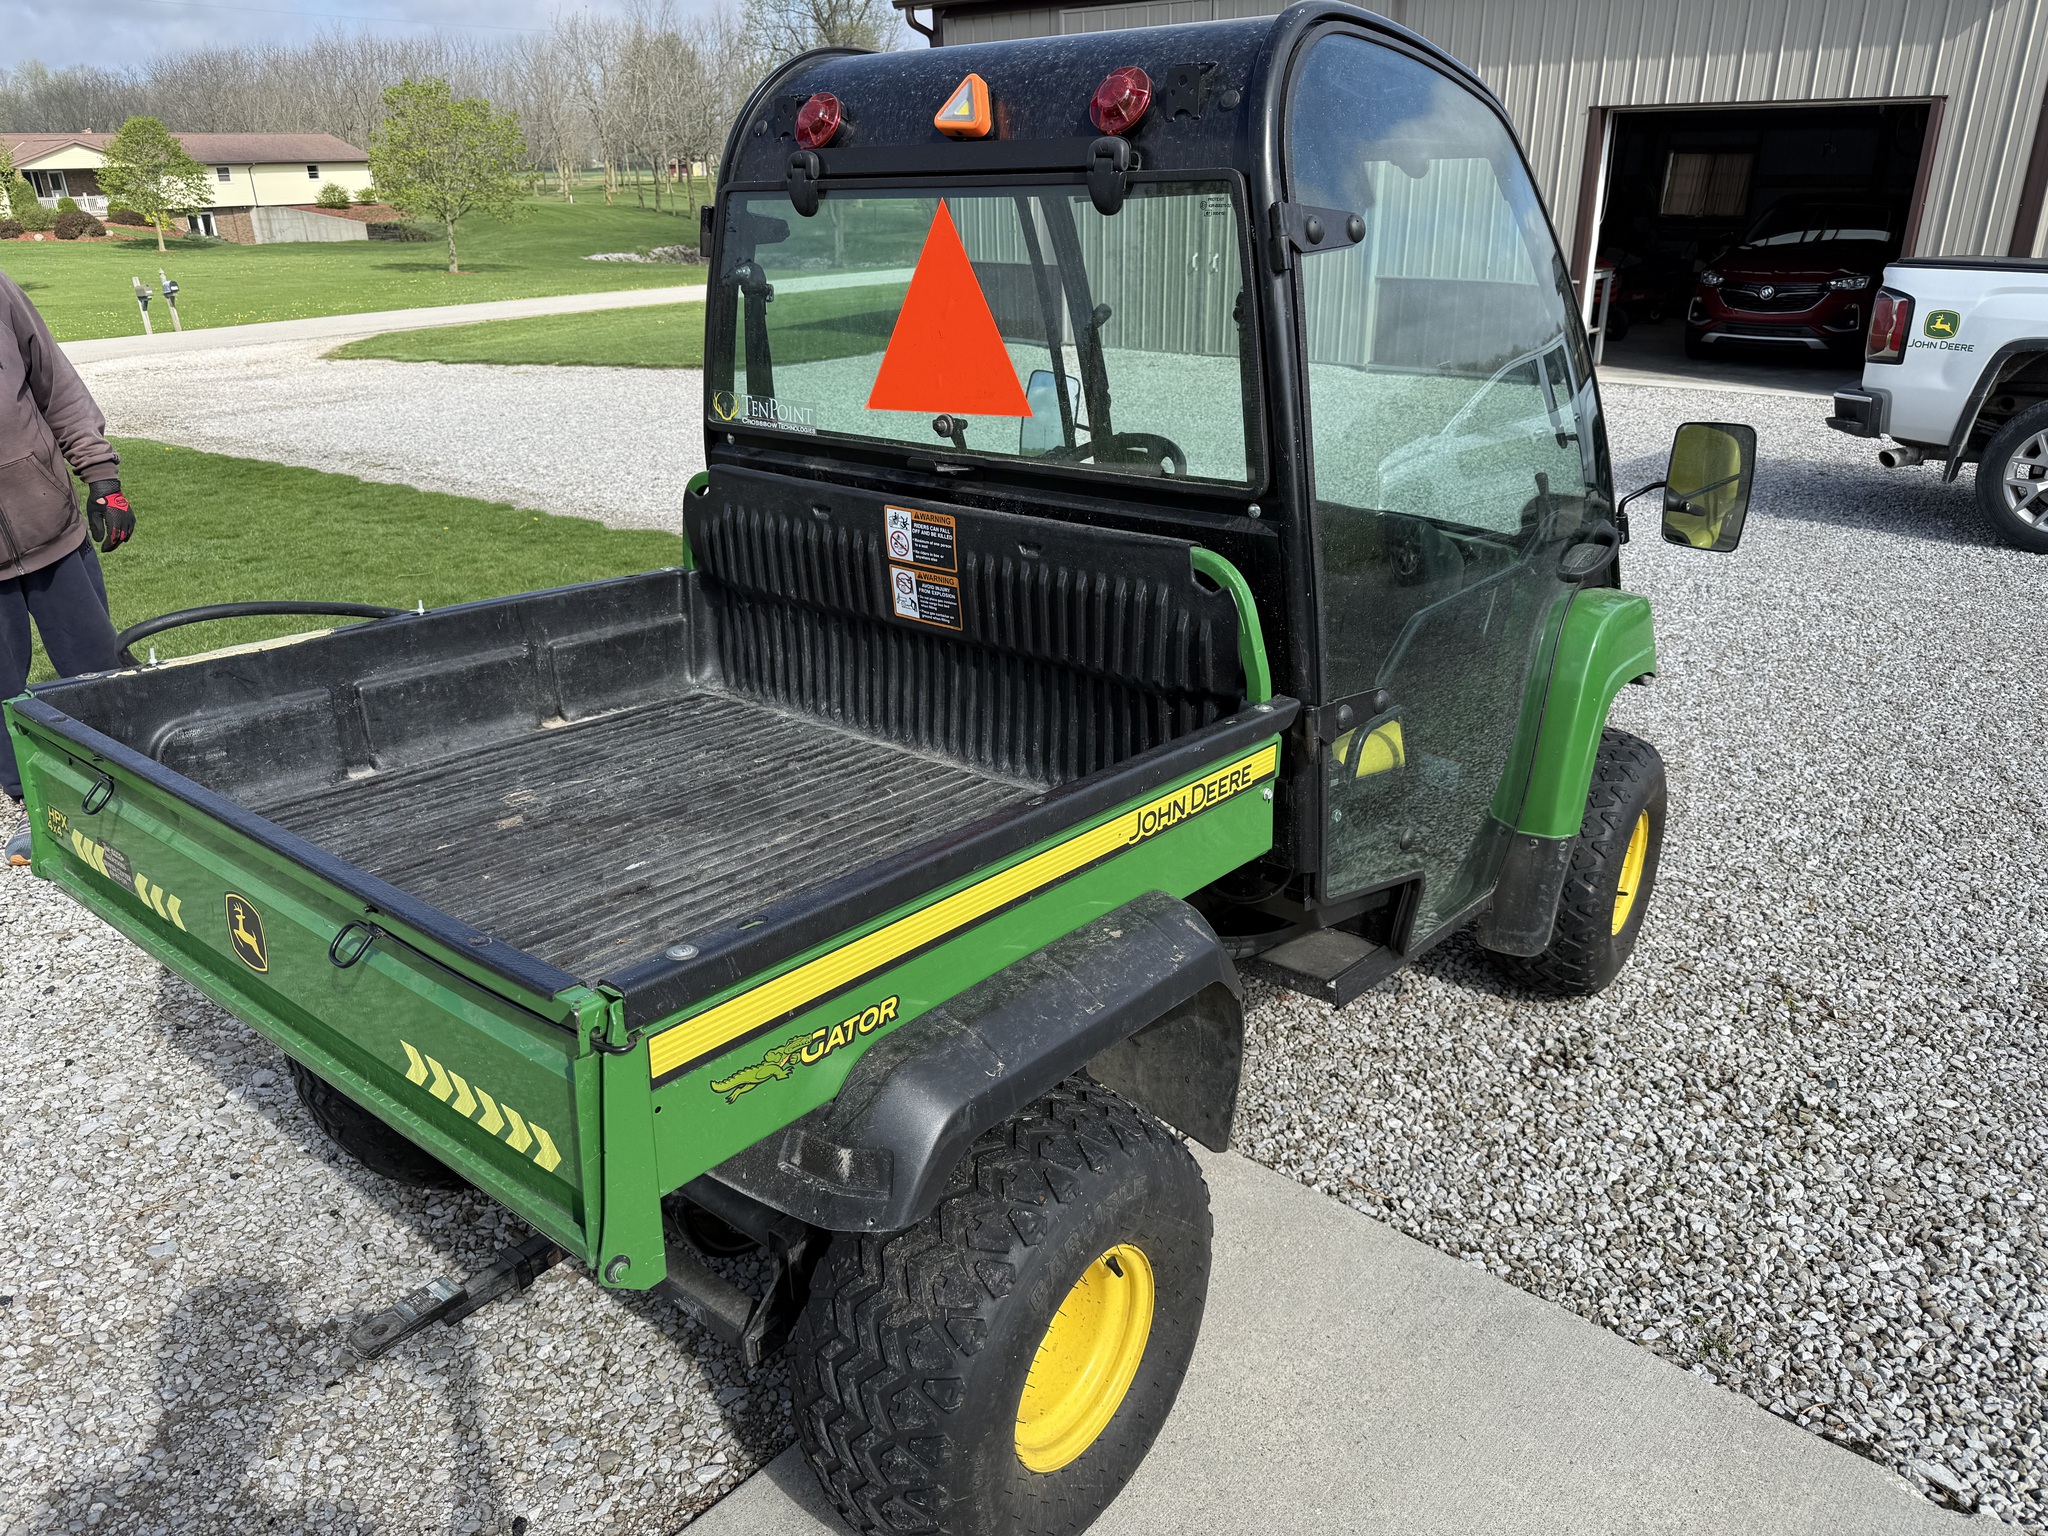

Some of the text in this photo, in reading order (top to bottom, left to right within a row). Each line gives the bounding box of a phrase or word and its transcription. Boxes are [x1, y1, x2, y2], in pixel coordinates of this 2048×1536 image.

[1908, 339, 1974, 352] JOHN DEERE
[920, 512, 951, 524] WARNING
[923, 573, 954, 585] WARNING
[931, 590, 956, 599] EXPLOSION
[1129, 764, 1252, 842] JOHN DEERE
[48, 805, 69, 831] HPX
[48, 820, 62, 836] 4x4
[800, 996, 899, 1065] GATOR
